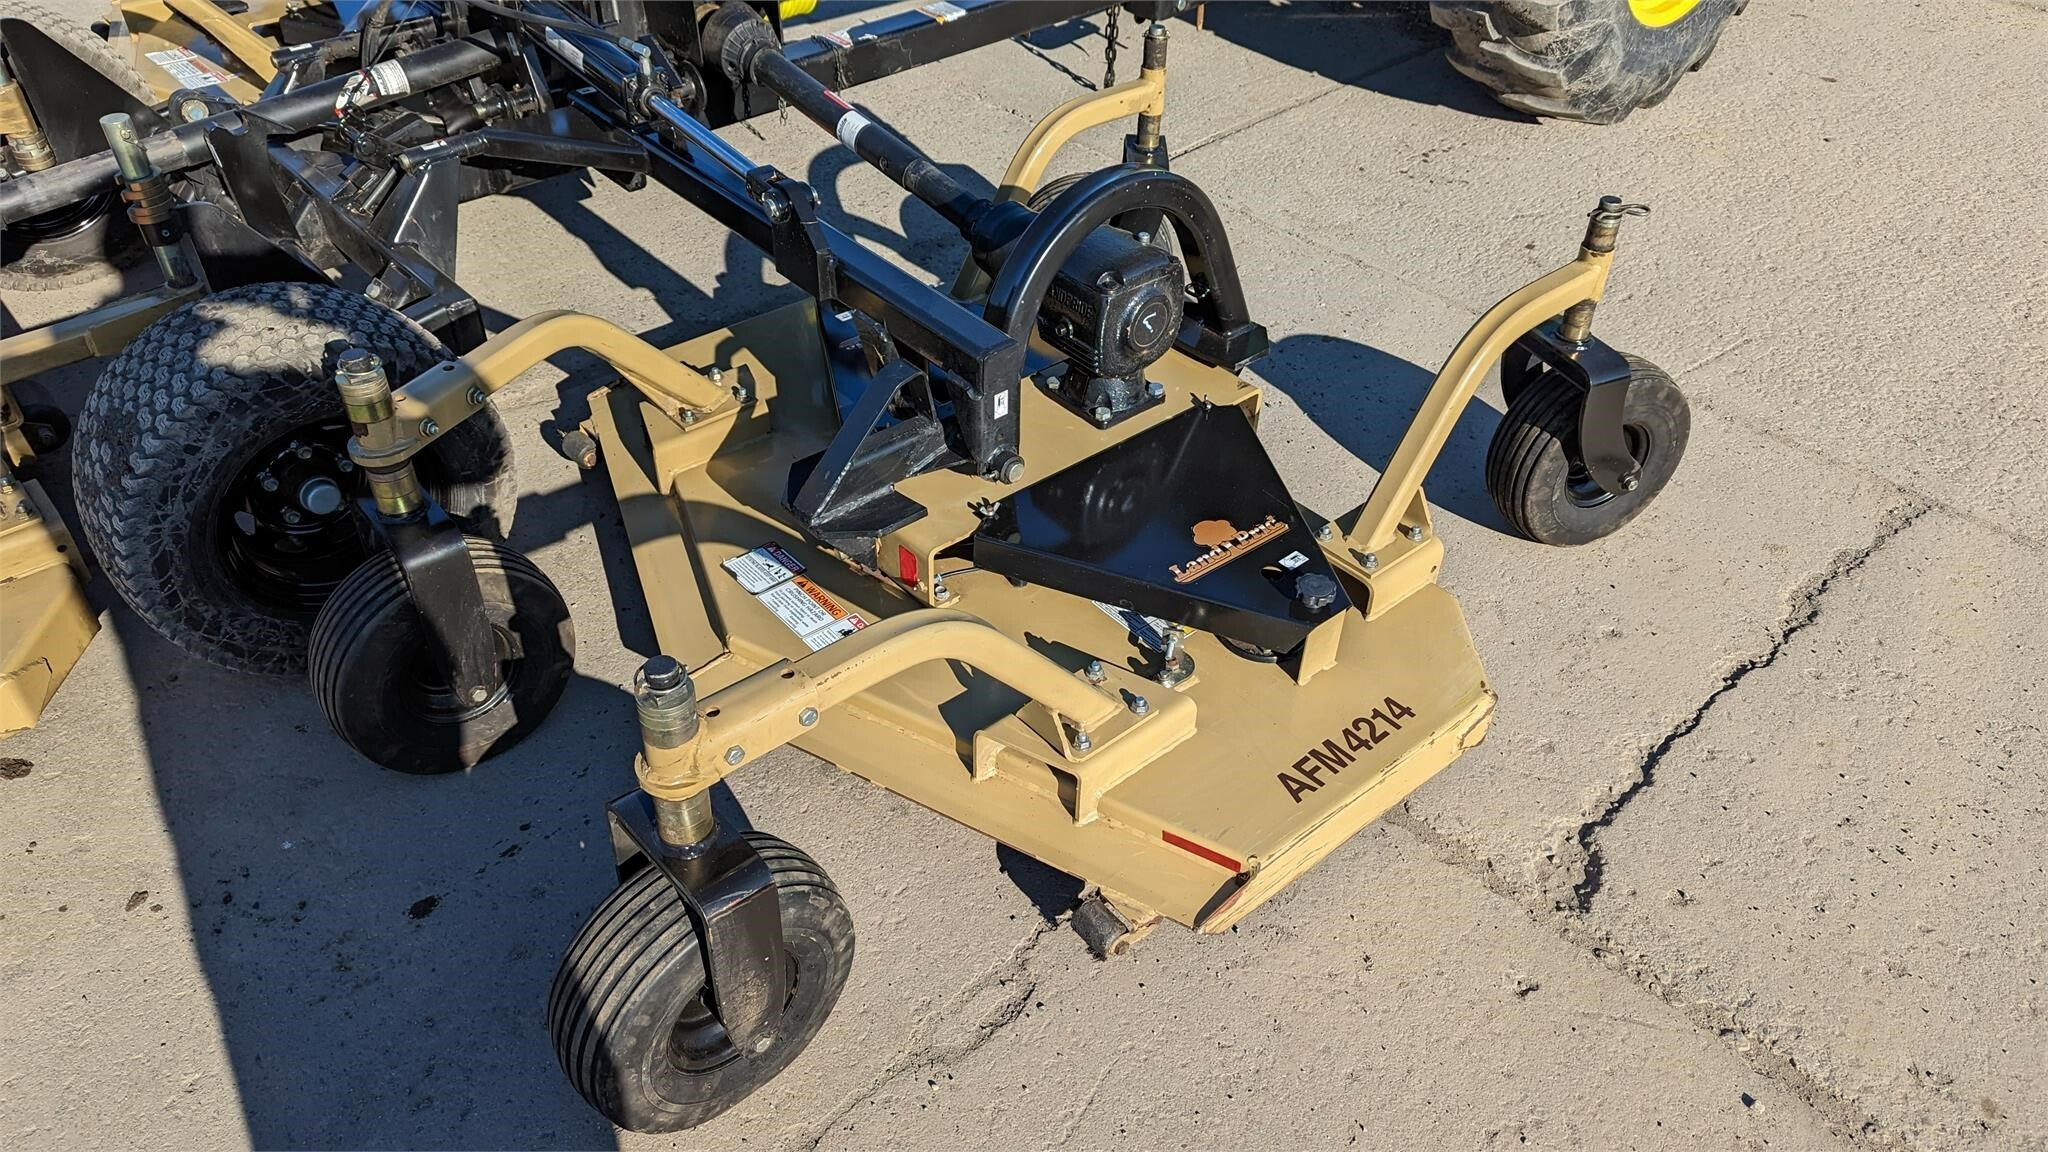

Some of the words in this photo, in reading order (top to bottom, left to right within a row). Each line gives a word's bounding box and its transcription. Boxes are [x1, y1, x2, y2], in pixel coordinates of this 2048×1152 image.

[774, 550, 800, 573] DANGER
[1168, 544, 1227, 578] Land
[806, 586, 842, 616] WARNING
[1277, 697, 1416, 803] AFM4214
